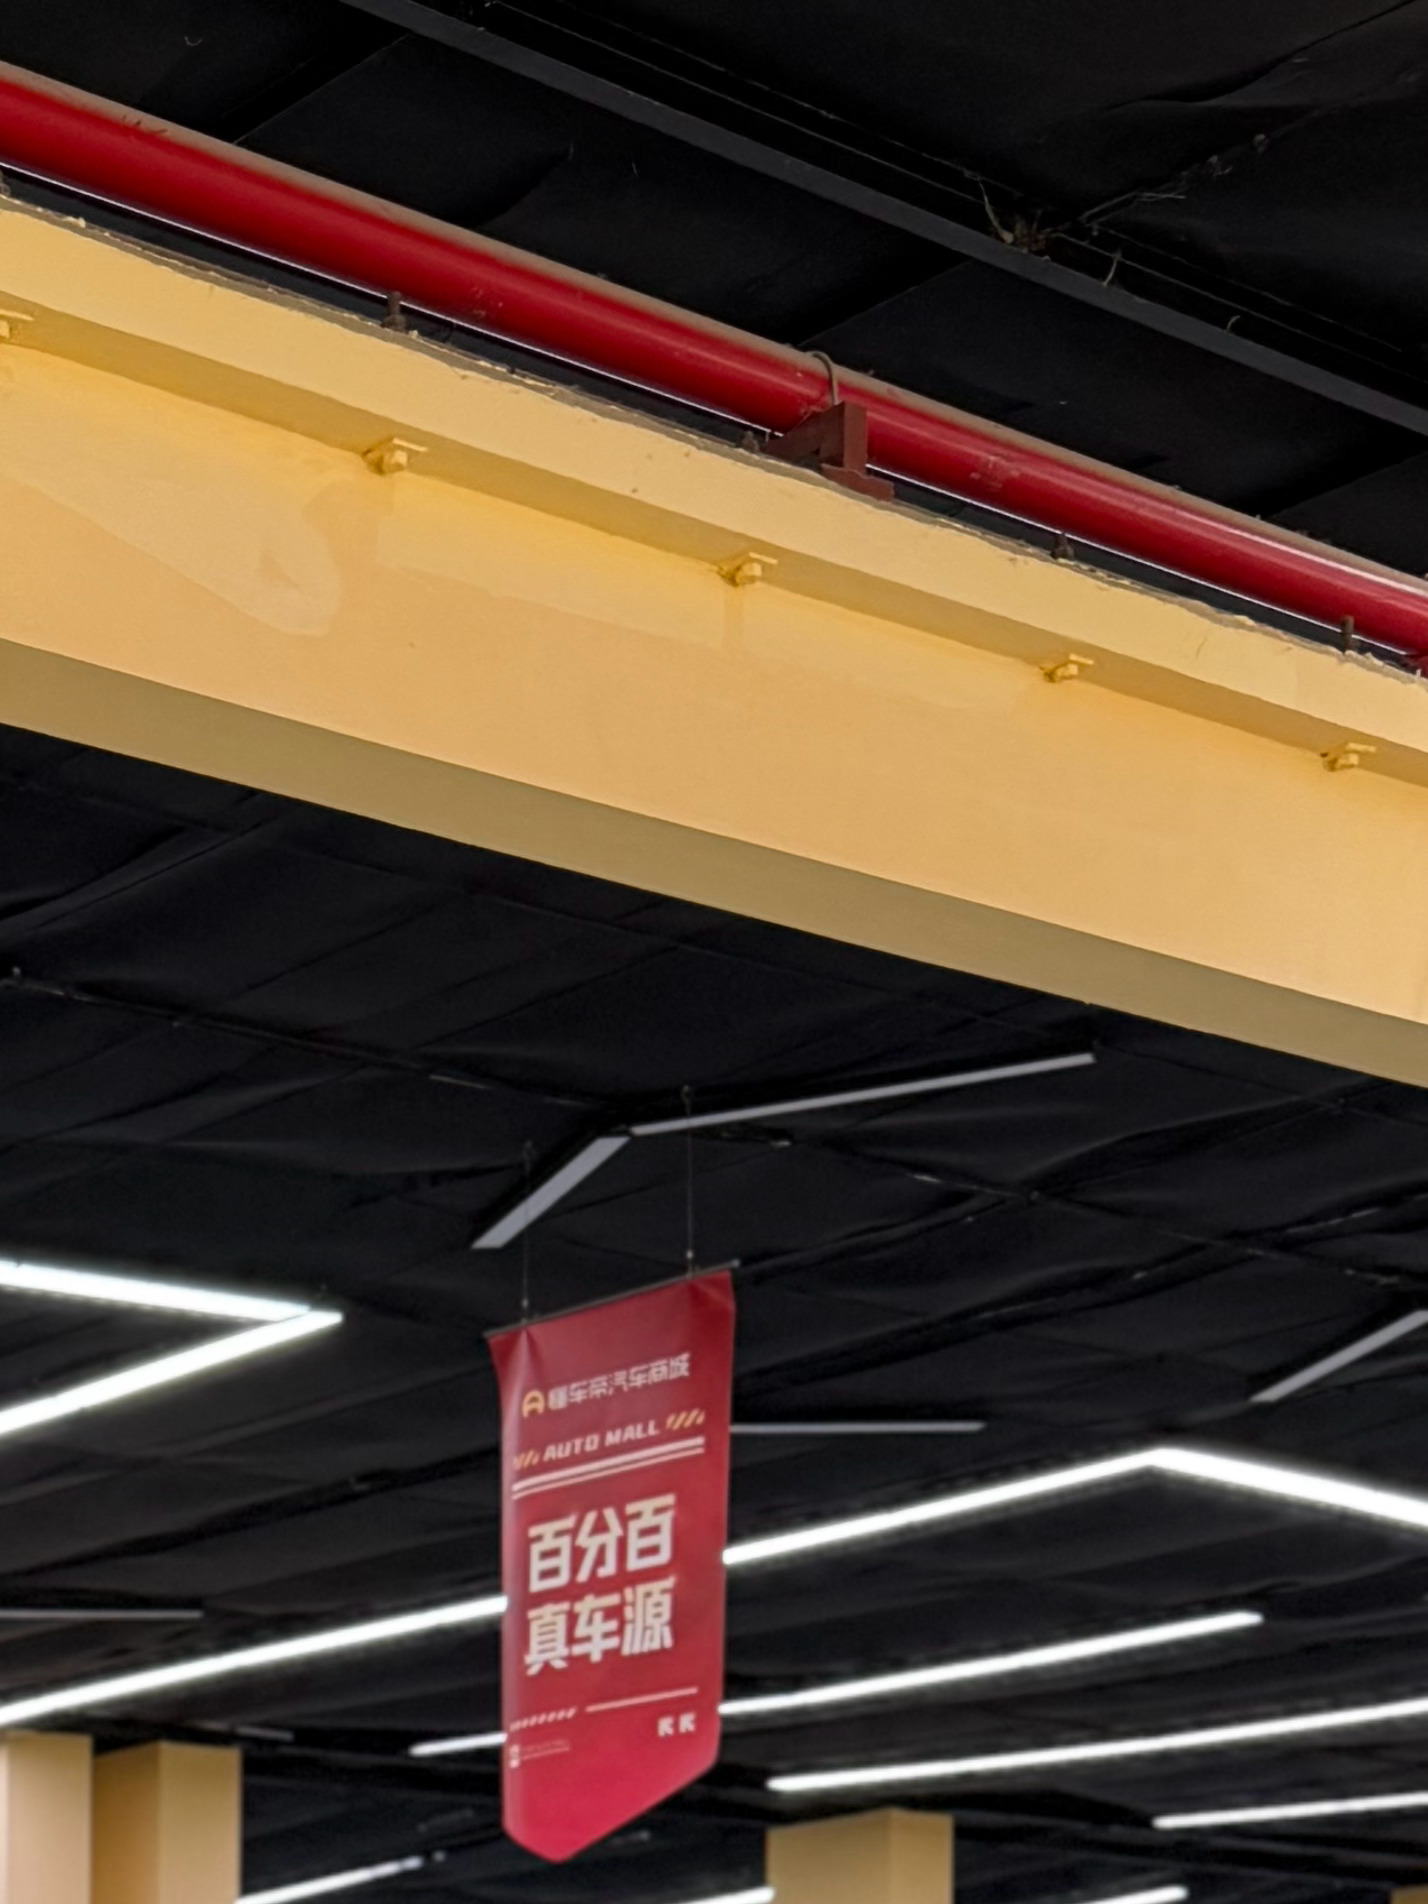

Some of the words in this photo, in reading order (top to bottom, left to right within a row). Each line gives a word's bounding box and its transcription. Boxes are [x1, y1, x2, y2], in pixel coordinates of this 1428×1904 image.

[548, 1352, 691, 1411] 懂车帝汽车商城
[543, 1434, 600, 1462] AUTO
[605, 1420, 660, 1447] MALL
[528, 1494, 676, 1593] 百分百
[524, 1576, 678, 1676] 真车源
